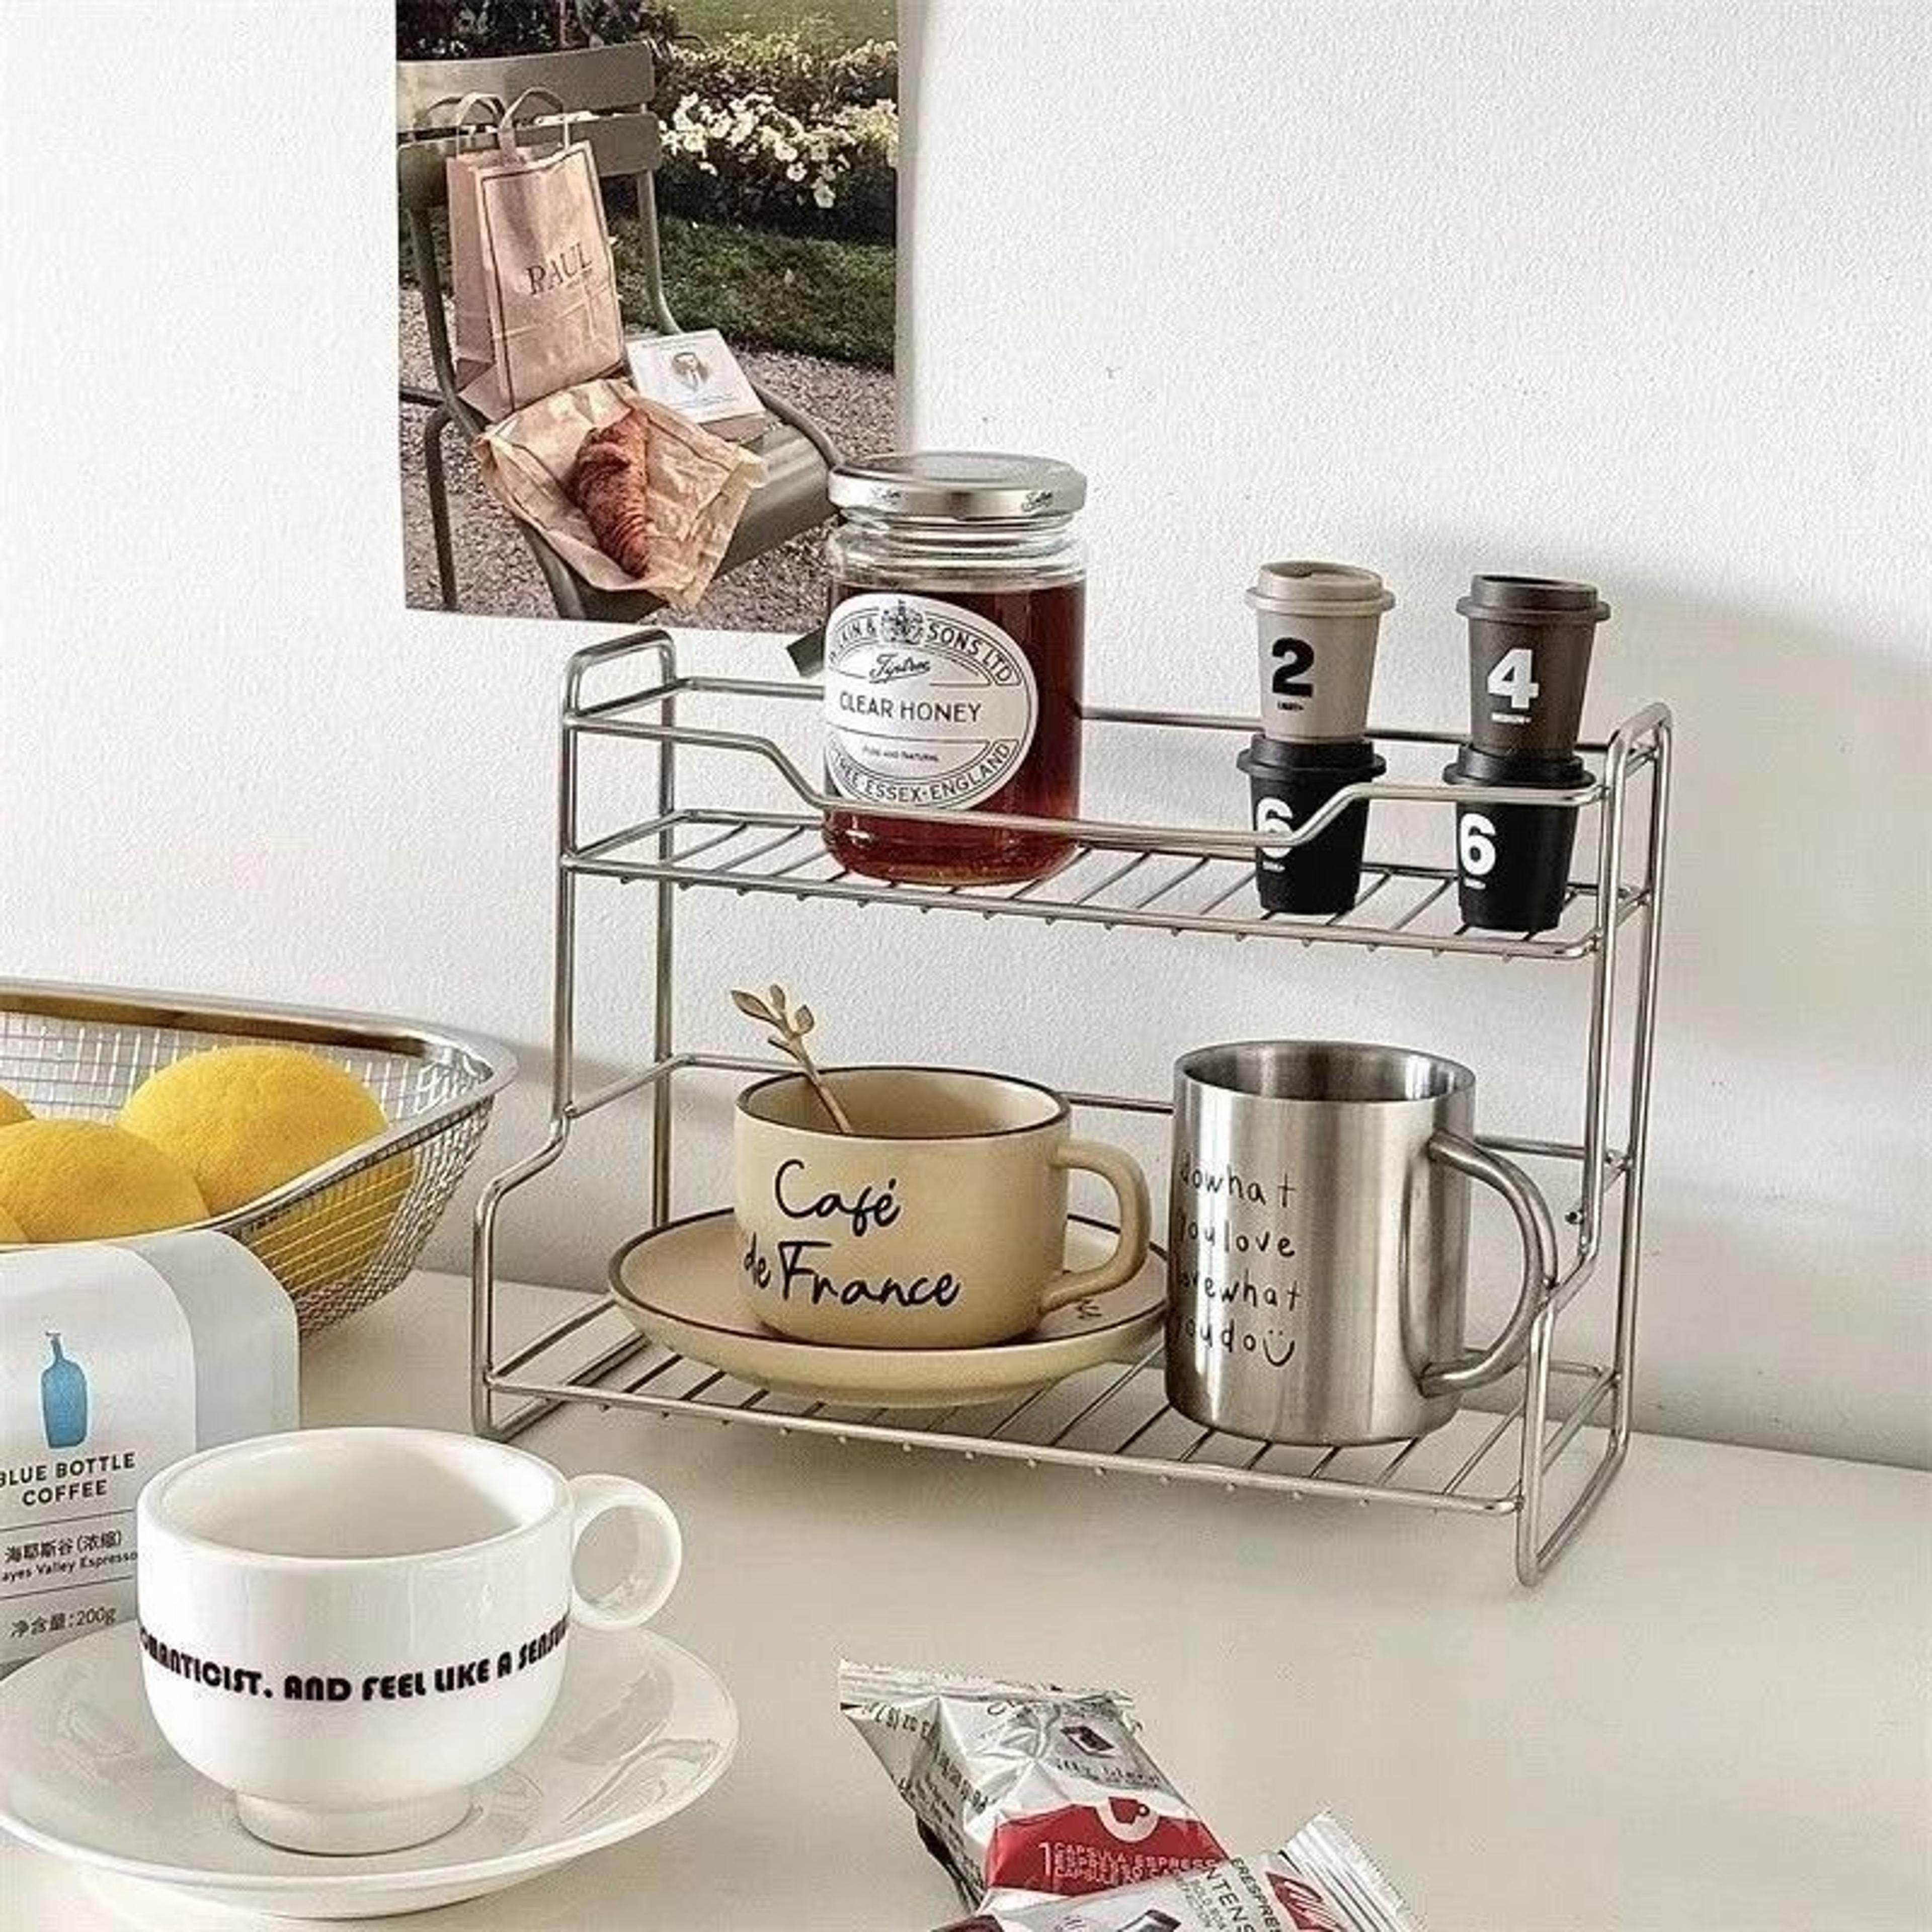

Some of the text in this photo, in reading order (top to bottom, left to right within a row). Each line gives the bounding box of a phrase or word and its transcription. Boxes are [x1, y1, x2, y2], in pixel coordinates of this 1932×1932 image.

[929, 622, 983, 655] SONS
[983, 648, 1013, 681] LTD
[1271, 637, 1315, 698] 2
[1487, 649, 1539, 709] 4
[840, 691, 983, 722] CLEAR HONEY
[865, 779, 922, 802] ESSEX
[930, 744, 1011, 800] ENGLAND
[1256, 797, 1294, 858] 6
[1460, 813, 1496, 875] 6
[775, 1159, 902, 1237] Café
[744, 1231, 960, 1307] de France
[23, 1480, 107, 1506] COFFEE
[56, 1452, 135, 1478] BOTTLE
[36, 1561, 75, 1575] Valley
[80, 1551, 138, 1568] Espresso
[284, 1674, 352, 1702] AND
[362, 1671, 426, 1702] FEEL
[434, 1658, 491, 1693] LIKE
[498, 1651, 512, 1678] A
[1232, 1857, 1285, 1932] ERESPRE
